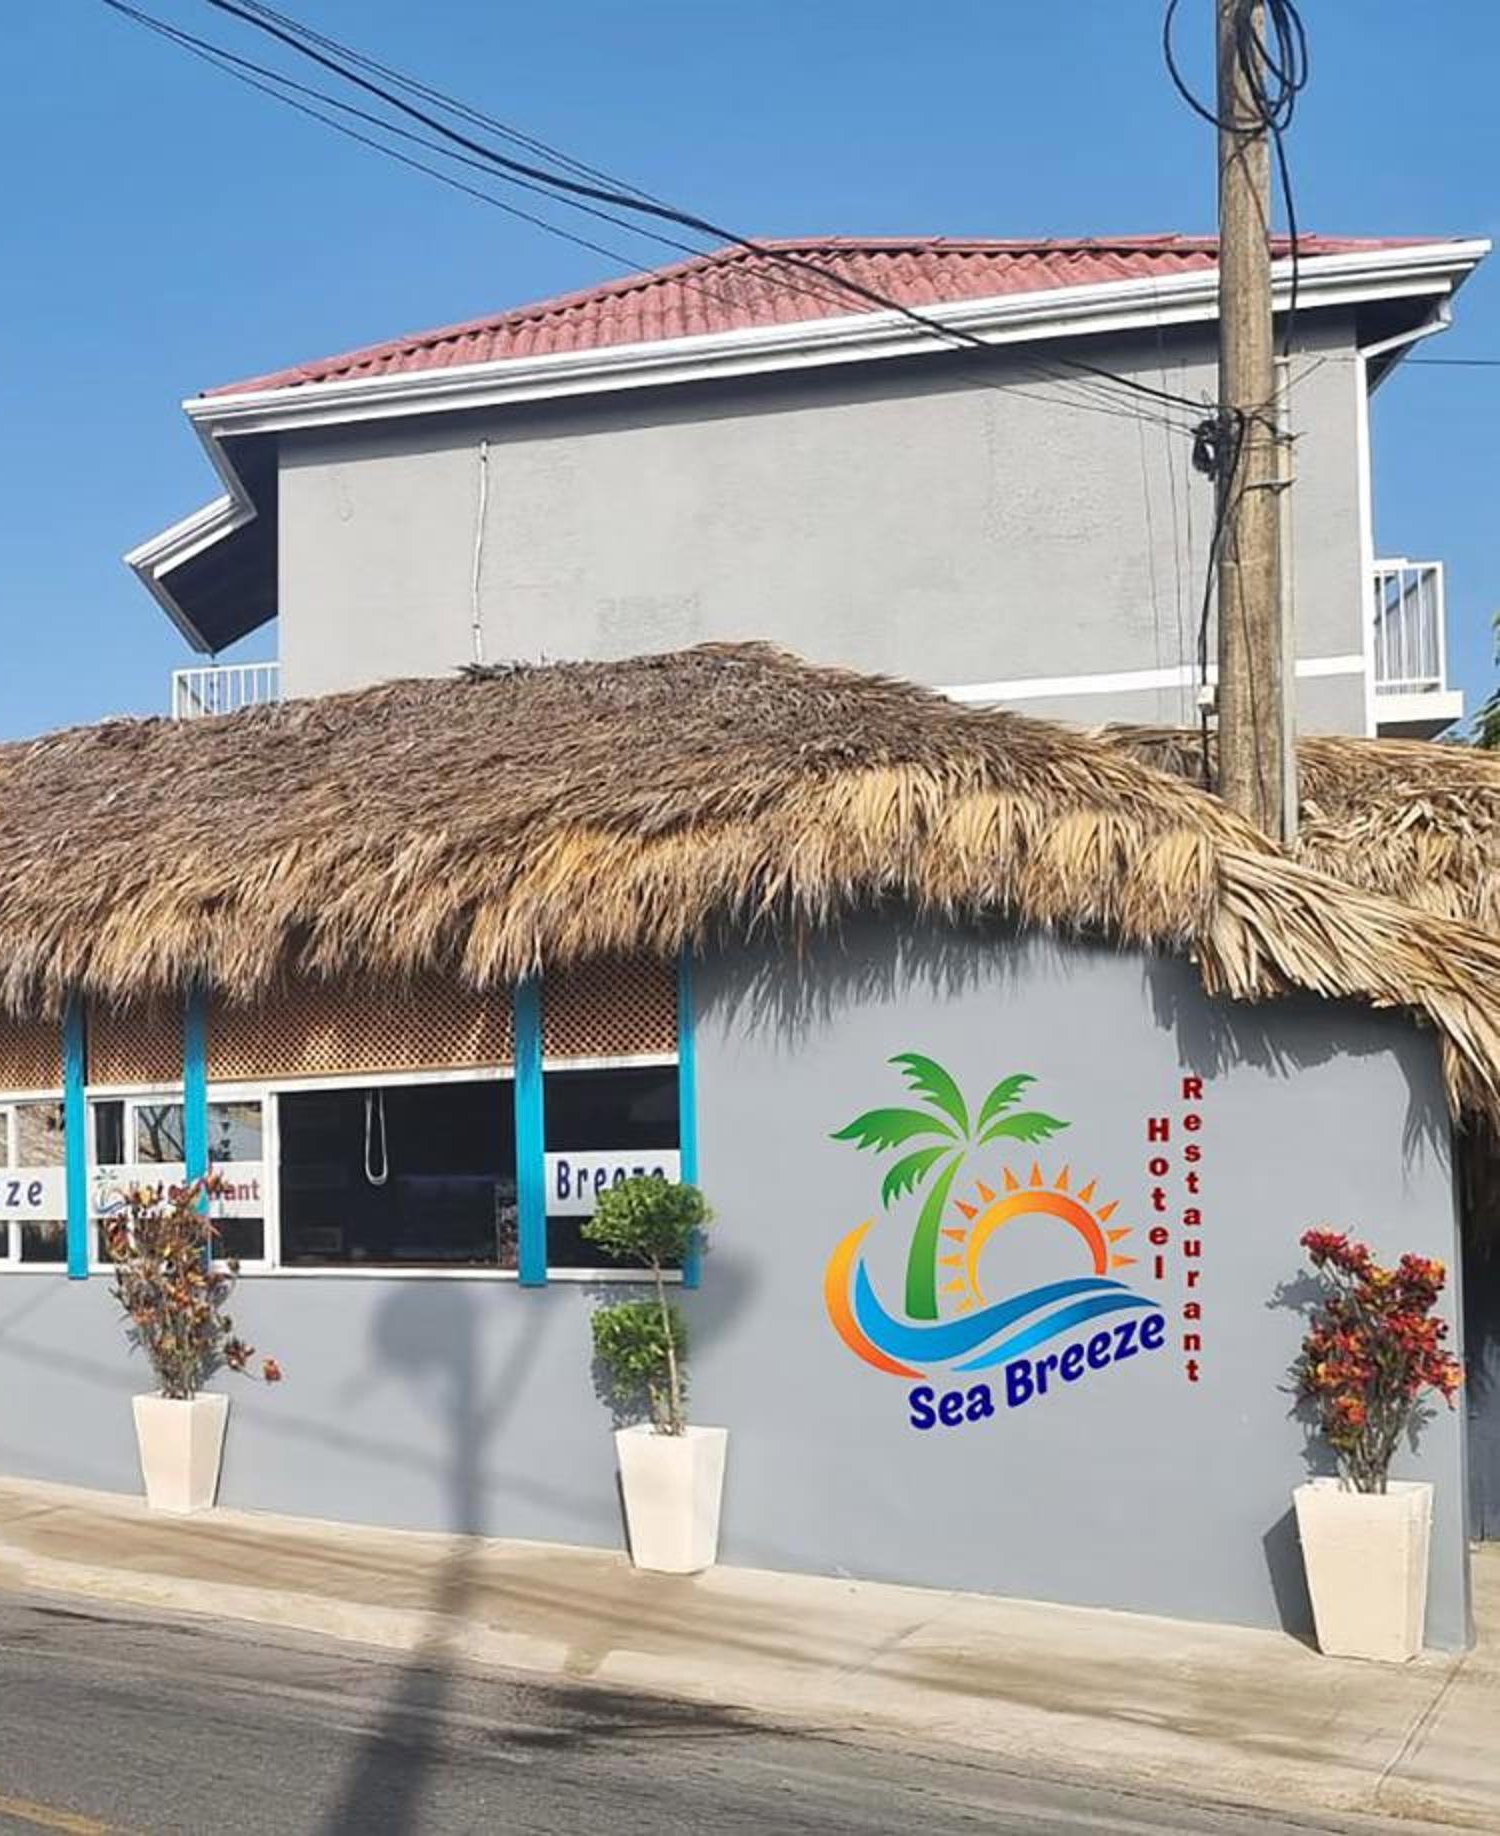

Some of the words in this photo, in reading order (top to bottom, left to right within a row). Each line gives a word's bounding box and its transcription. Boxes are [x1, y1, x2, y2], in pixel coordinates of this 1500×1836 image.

[1148, 1118, 1170, 1280] Hotel
[1182, 1077, 1203, 1383] Restaurant
[908, 1382, 995, 1430] Sea
[1004, 1312, 1167, 1408] Breeze
